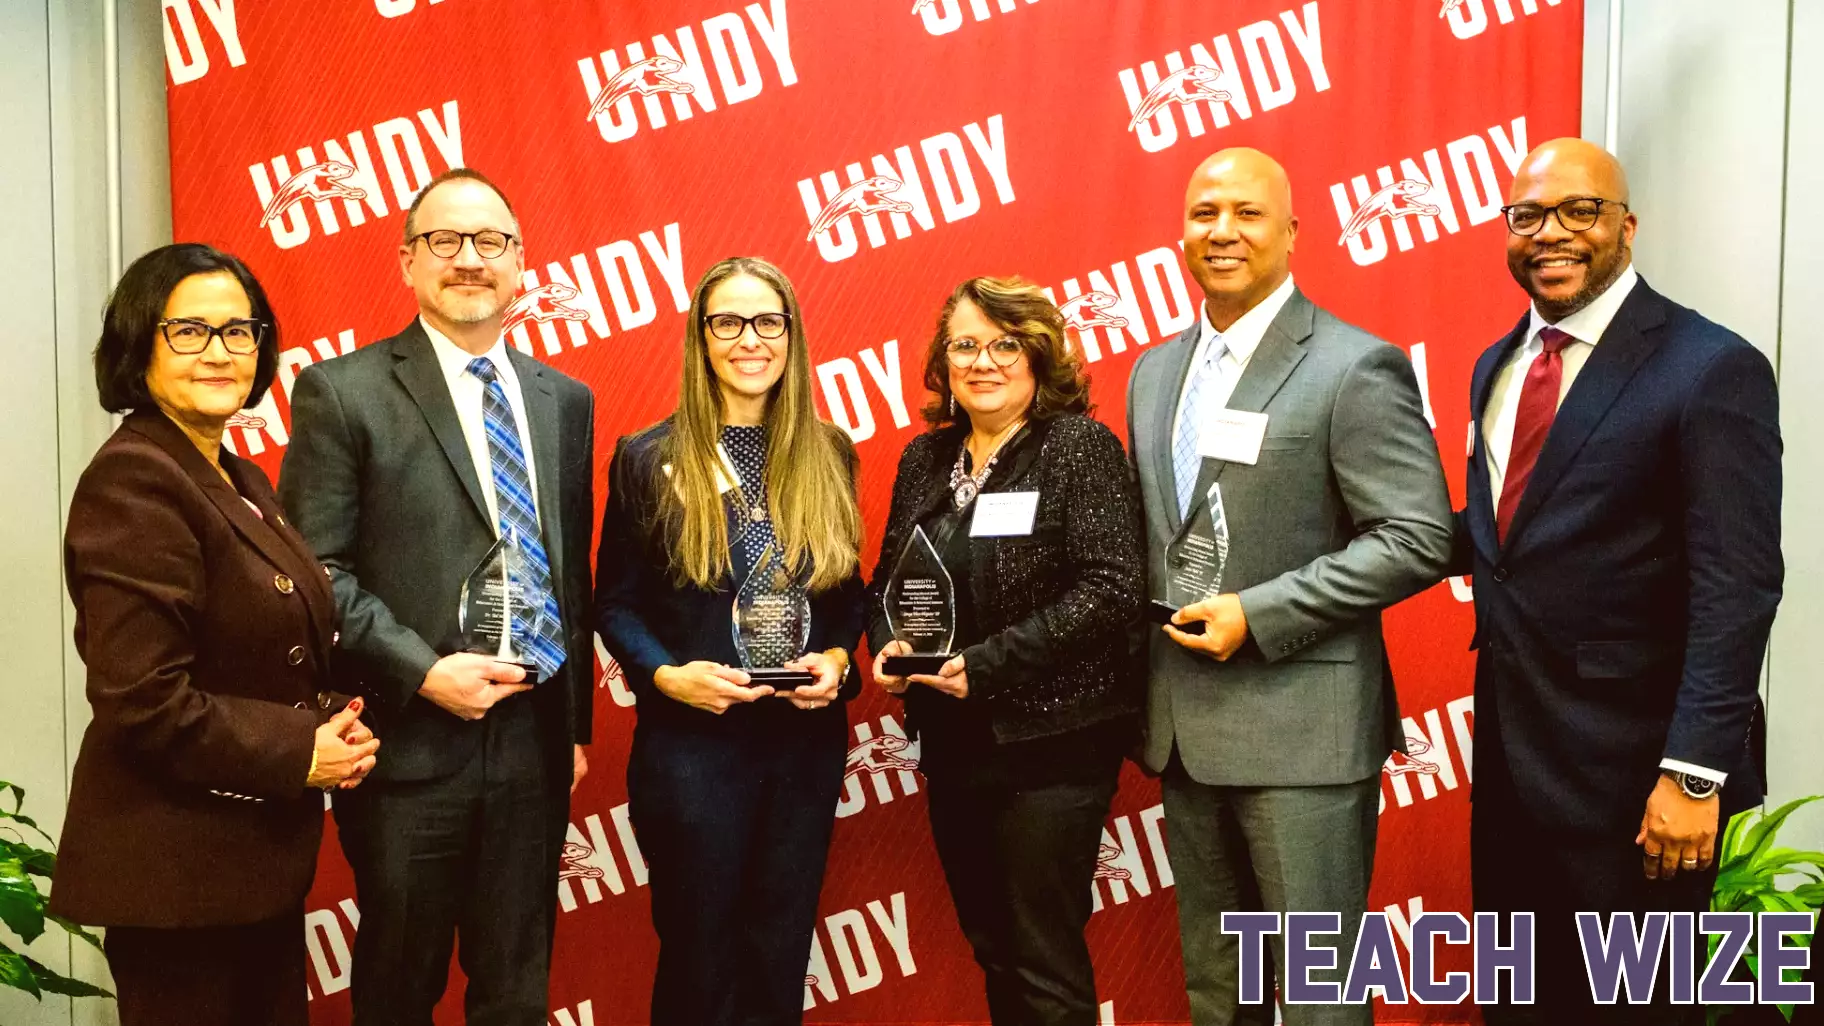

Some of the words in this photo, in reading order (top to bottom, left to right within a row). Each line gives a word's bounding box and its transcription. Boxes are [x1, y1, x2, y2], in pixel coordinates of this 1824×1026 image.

[577, 0, 798, 143] UINDY
[1118, 1, 1331, 152] UINDY
[797, 113, 1016, 263] UINDY
[503, 222, 692, 357] INDY
